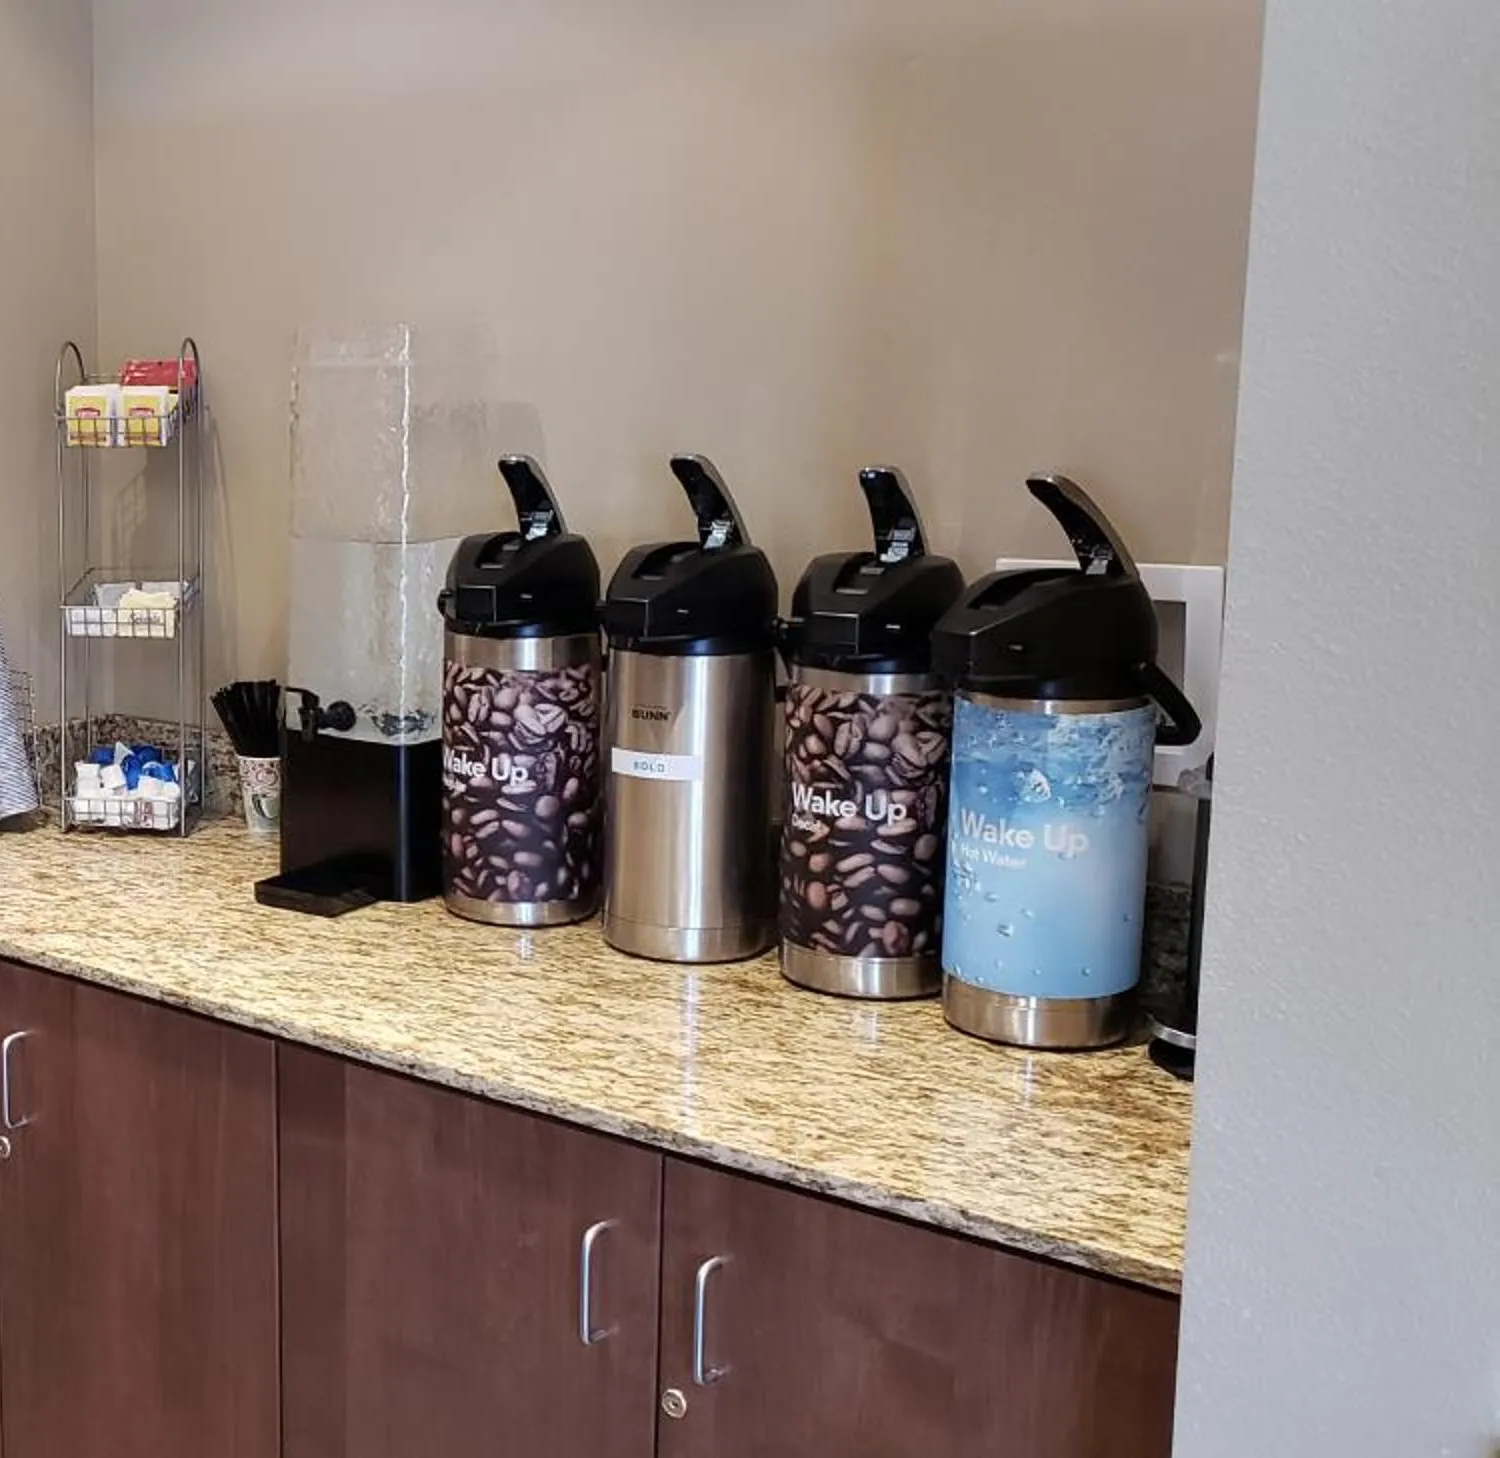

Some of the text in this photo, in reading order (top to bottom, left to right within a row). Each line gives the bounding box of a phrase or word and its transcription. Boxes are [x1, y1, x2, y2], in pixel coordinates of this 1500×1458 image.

[631, 708, 669, 720] BUNN
[491, 757, 529, 787] Up
[791, 781, 908, 826] Wake Up
[960, 807, 1090, 858] Wake Up
